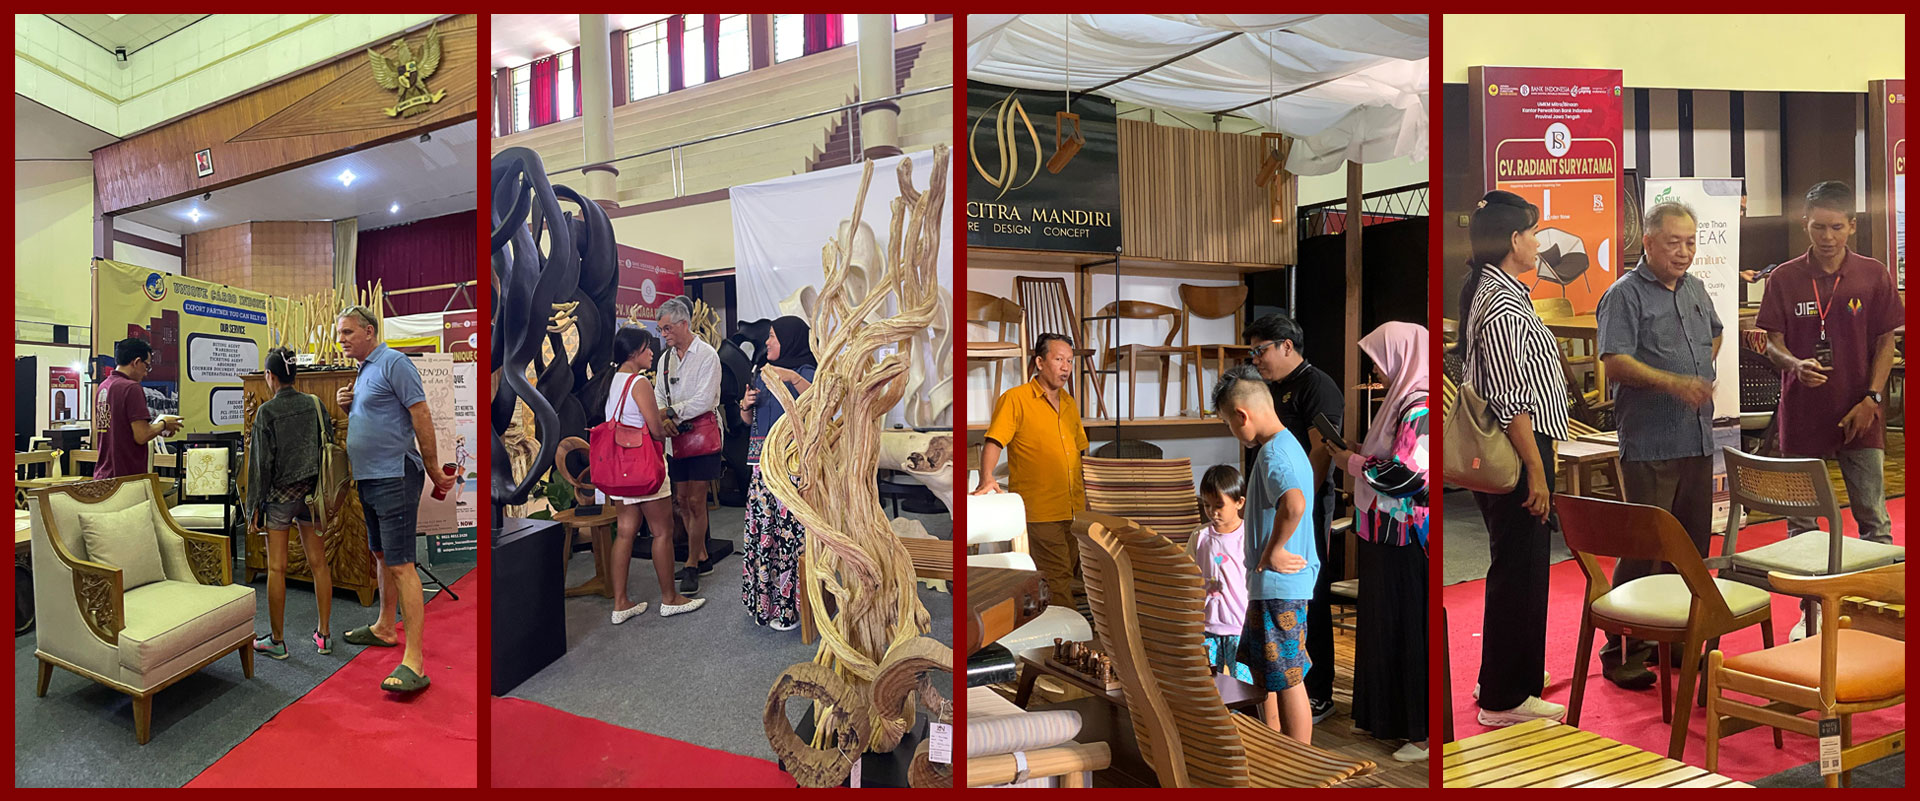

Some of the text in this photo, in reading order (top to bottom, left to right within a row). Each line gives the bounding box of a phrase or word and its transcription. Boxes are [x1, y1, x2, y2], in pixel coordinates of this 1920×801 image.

[1499, 157, 1613, 176] CV. RADIANT SURYATAMA
[966, 201, 1112, 227] CITRA MANDIRI
[993, 223, 1032, 234] DESIGN
[1043, 227, 1090, 238] CONCEPT
[1711, 220, 1727, 229] Than
[1693, 255, 1726, 265] urniture
[173, 282, 208, 300] UNIQUE
[210, 290, 237, 304] CARGO
[185, 302, 206, 312] EXPORT
[206, 306, 229, 316] PARTNER
[229, 310, 239, 318] YOU
[239, 312, 250, 320] CAN
[220, 323, 246, 335] OUR SERVICE
